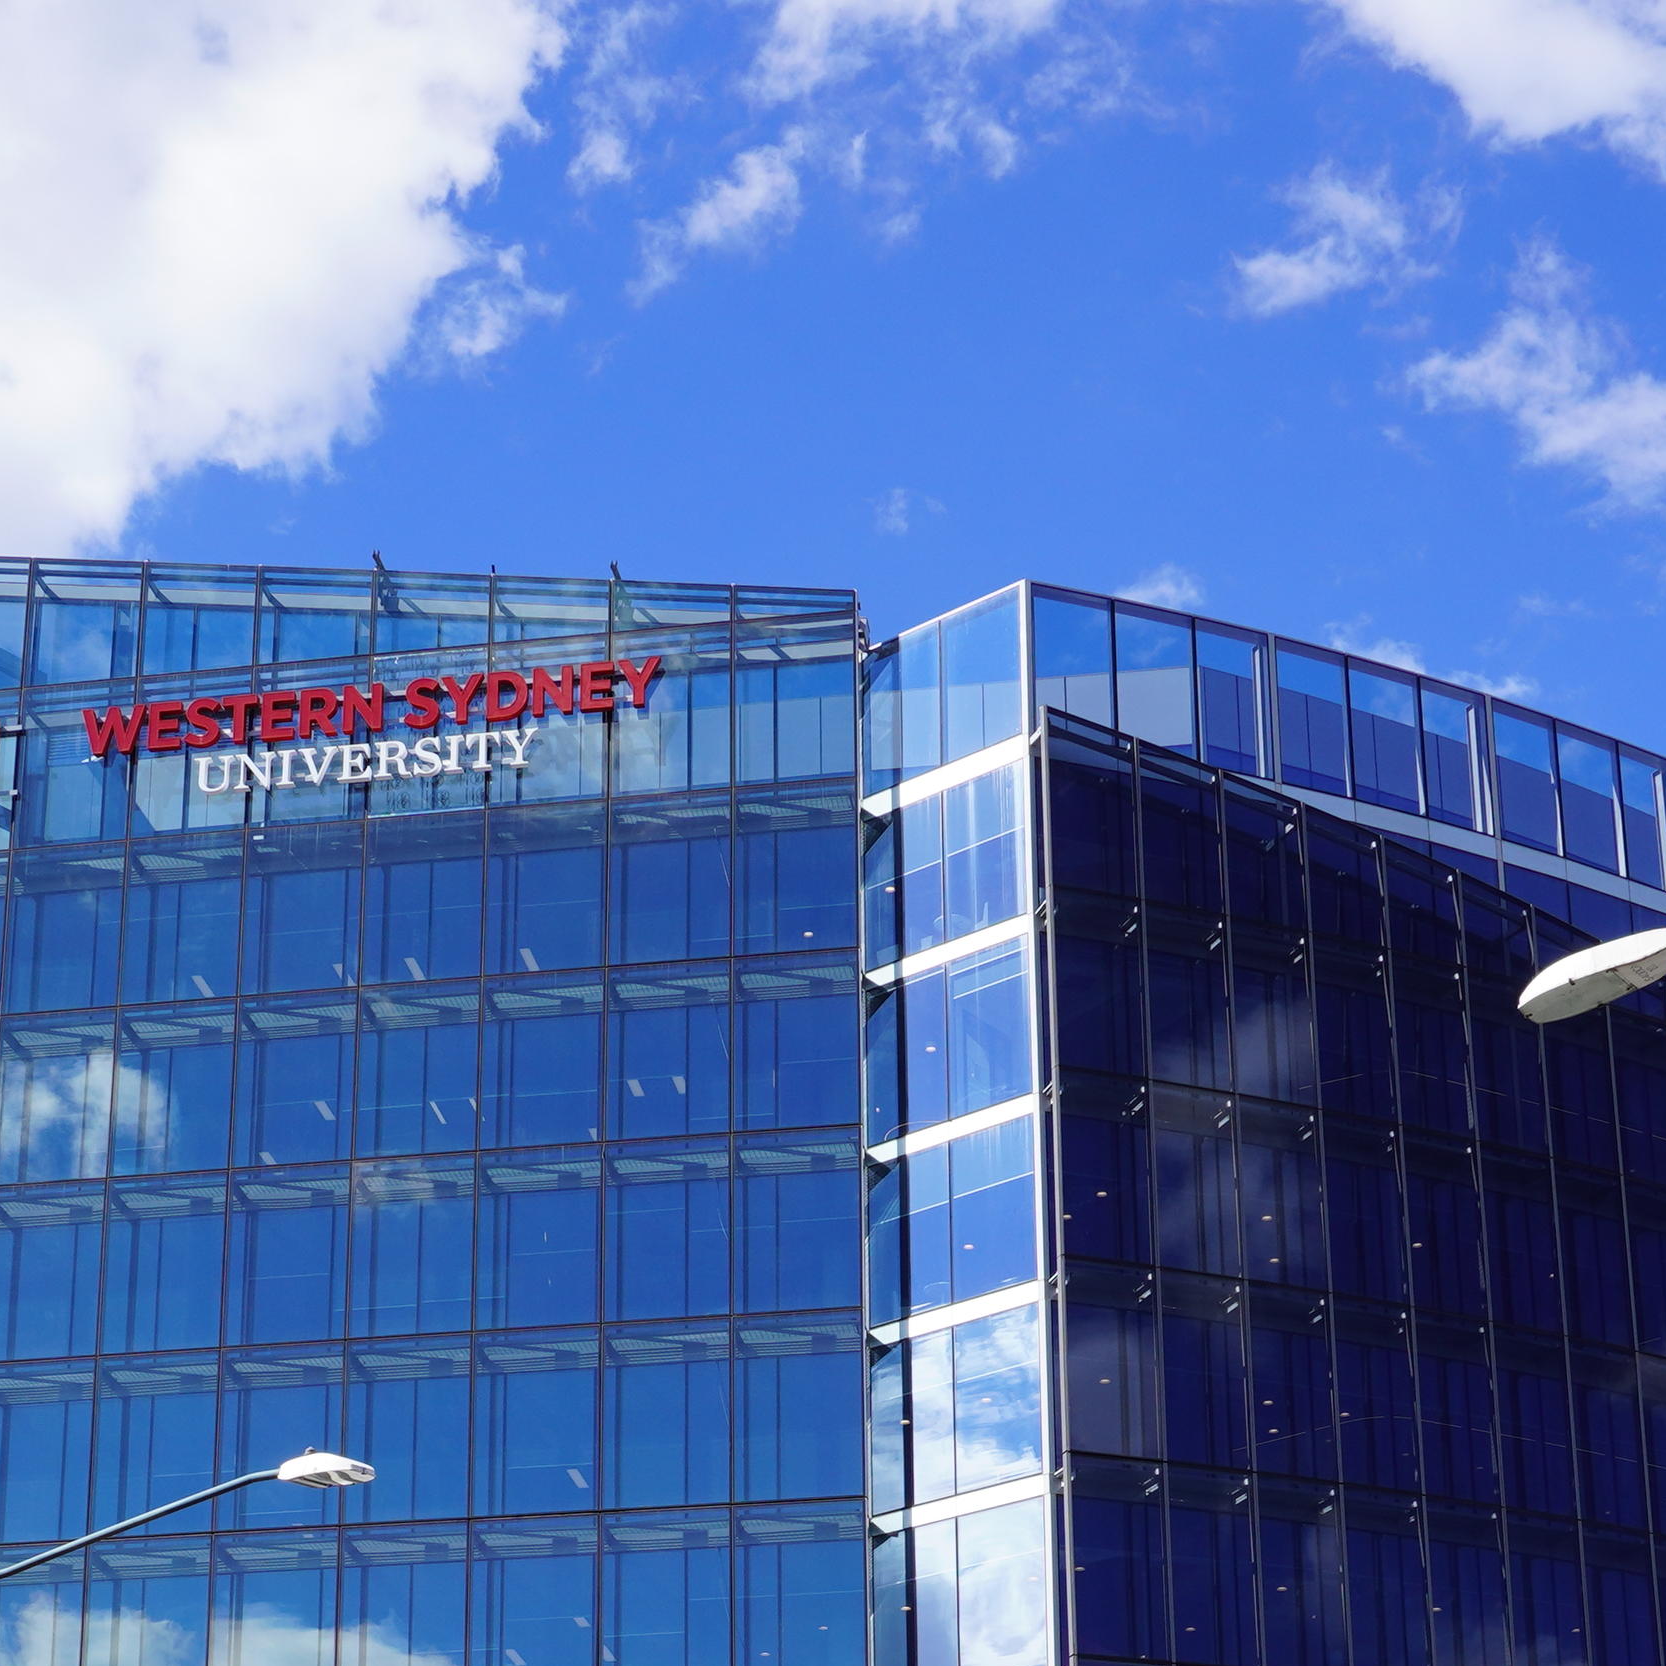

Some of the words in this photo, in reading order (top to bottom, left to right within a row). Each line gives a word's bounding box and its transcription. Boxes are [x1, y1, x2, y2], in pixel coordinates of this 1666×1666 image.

[82, 682, 385, 757] WESTERN
[405, 655, 662, 730] SYDNEY
[195, 728, 537, 794] UNIVERSITY
